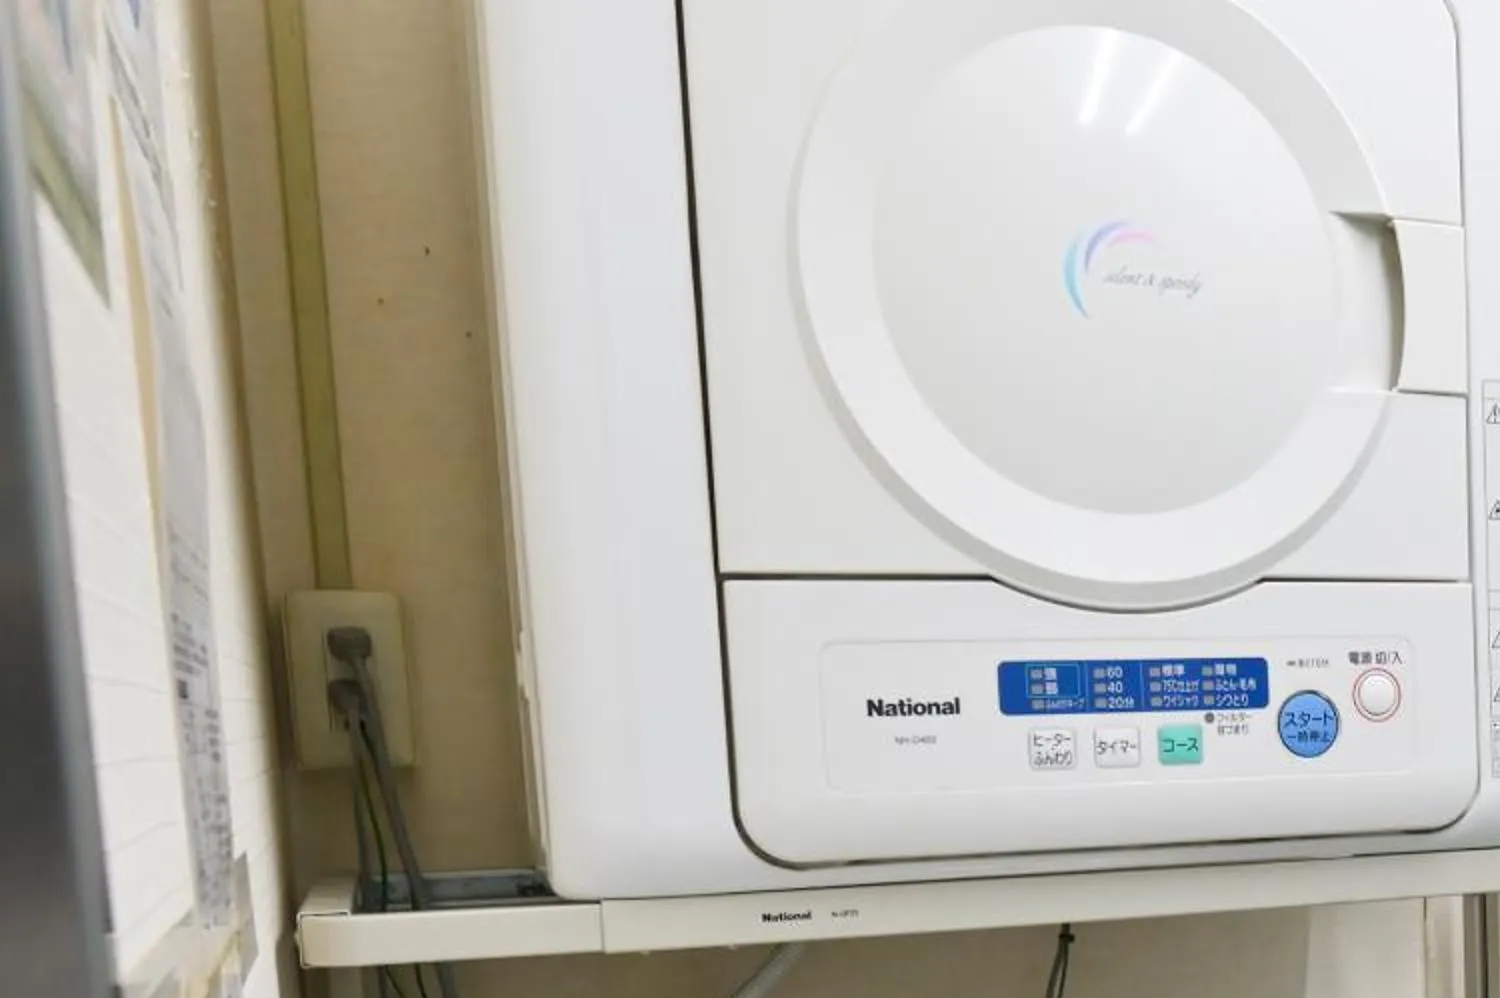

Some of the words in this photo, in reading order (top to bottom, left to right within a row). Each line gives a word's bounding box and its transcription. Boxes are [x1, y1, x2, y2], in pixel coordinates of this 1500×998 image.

[1107, 665, 1124, 679] 60
[1107, 681, 1124, 693] 40
[866, 697, 960, 717] National
[1283, 708, 1335, 728] スタート
[1033, 733, 1071, 749] ヒーター
[1286, 730, 1331, 743] 一時停止
[1095, 740, 1136, 755] タイマー
[1163, 738, 1199, 753] コース
[761, 910, 812, 922] National
